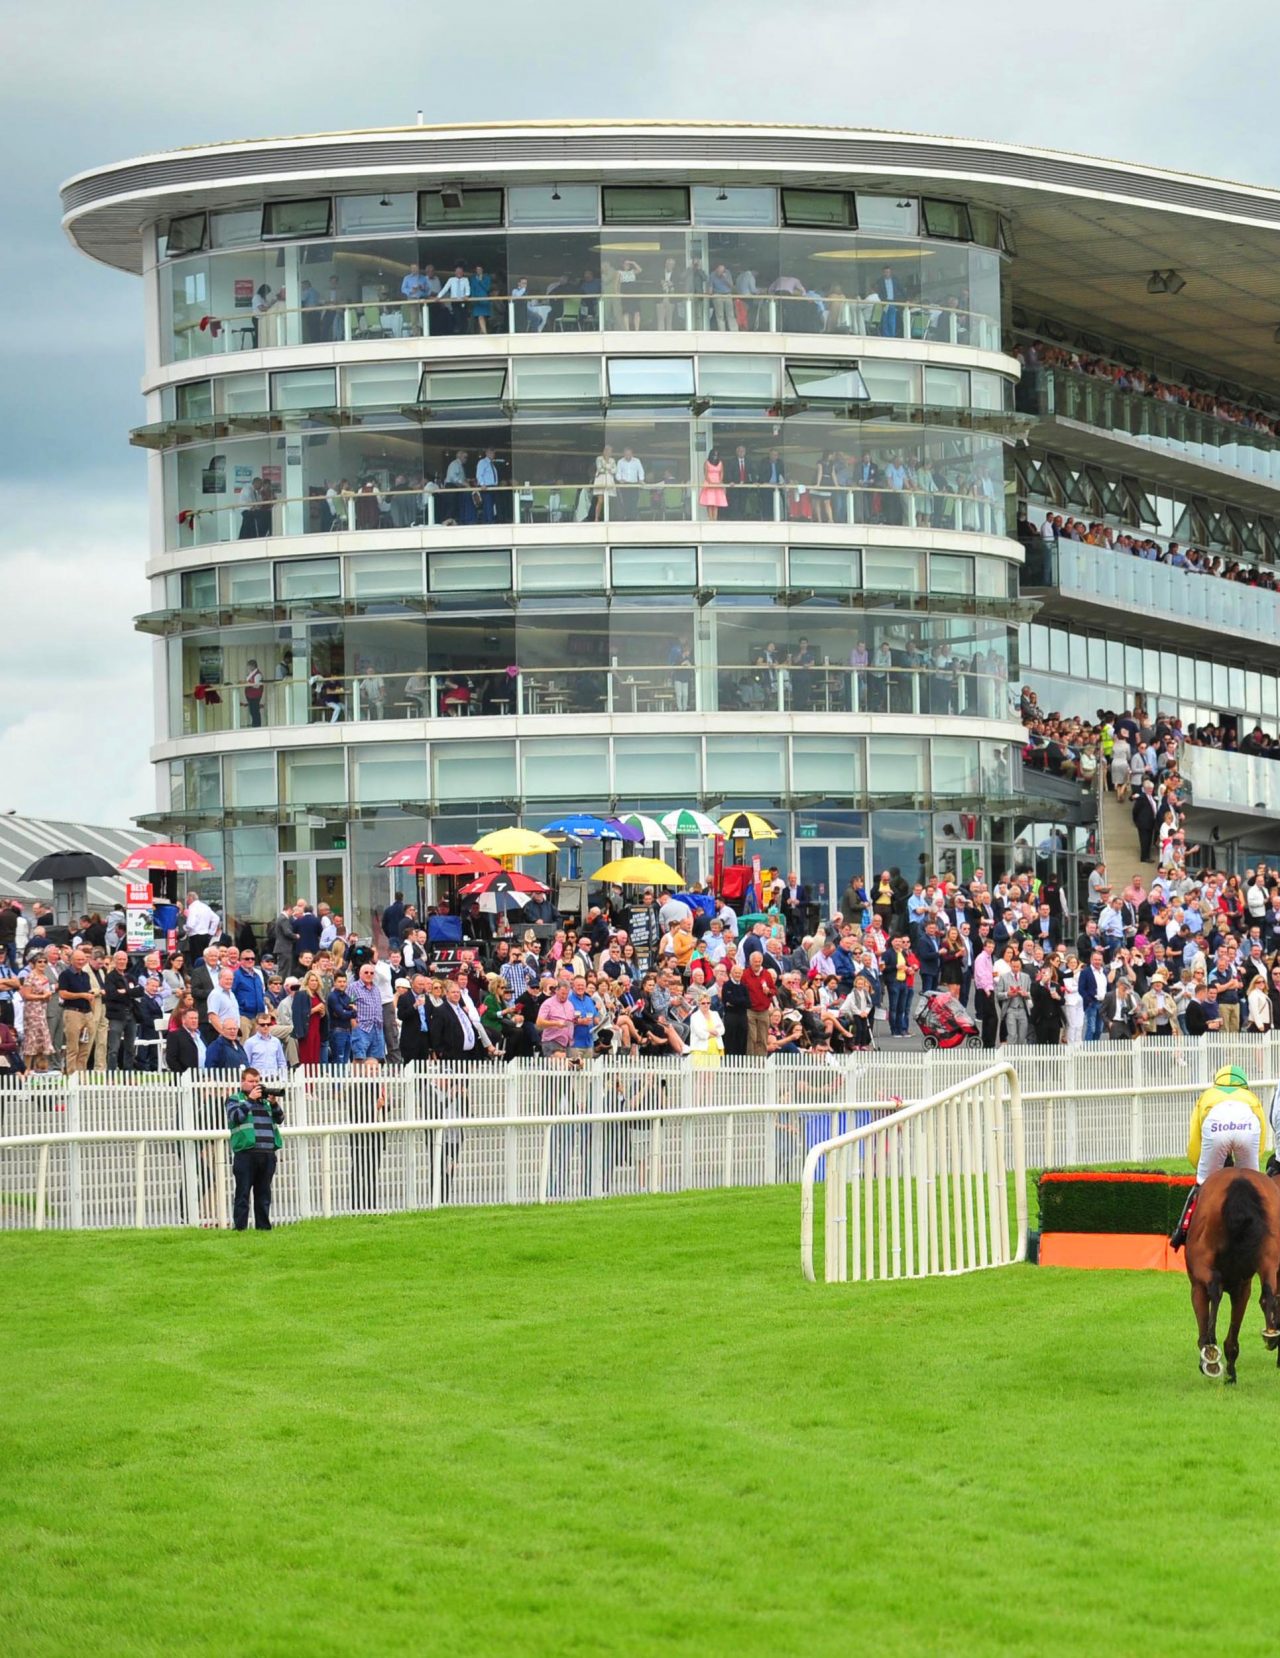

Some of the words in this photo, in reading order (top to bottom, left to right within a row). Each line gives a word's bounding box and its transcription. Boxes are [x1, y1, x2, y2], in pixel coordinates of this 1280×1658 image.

[423, 854, 434, 863] 7
[496, 883, 507, 892] 7
[1210, 1121, 1252, 1133] Stobart
